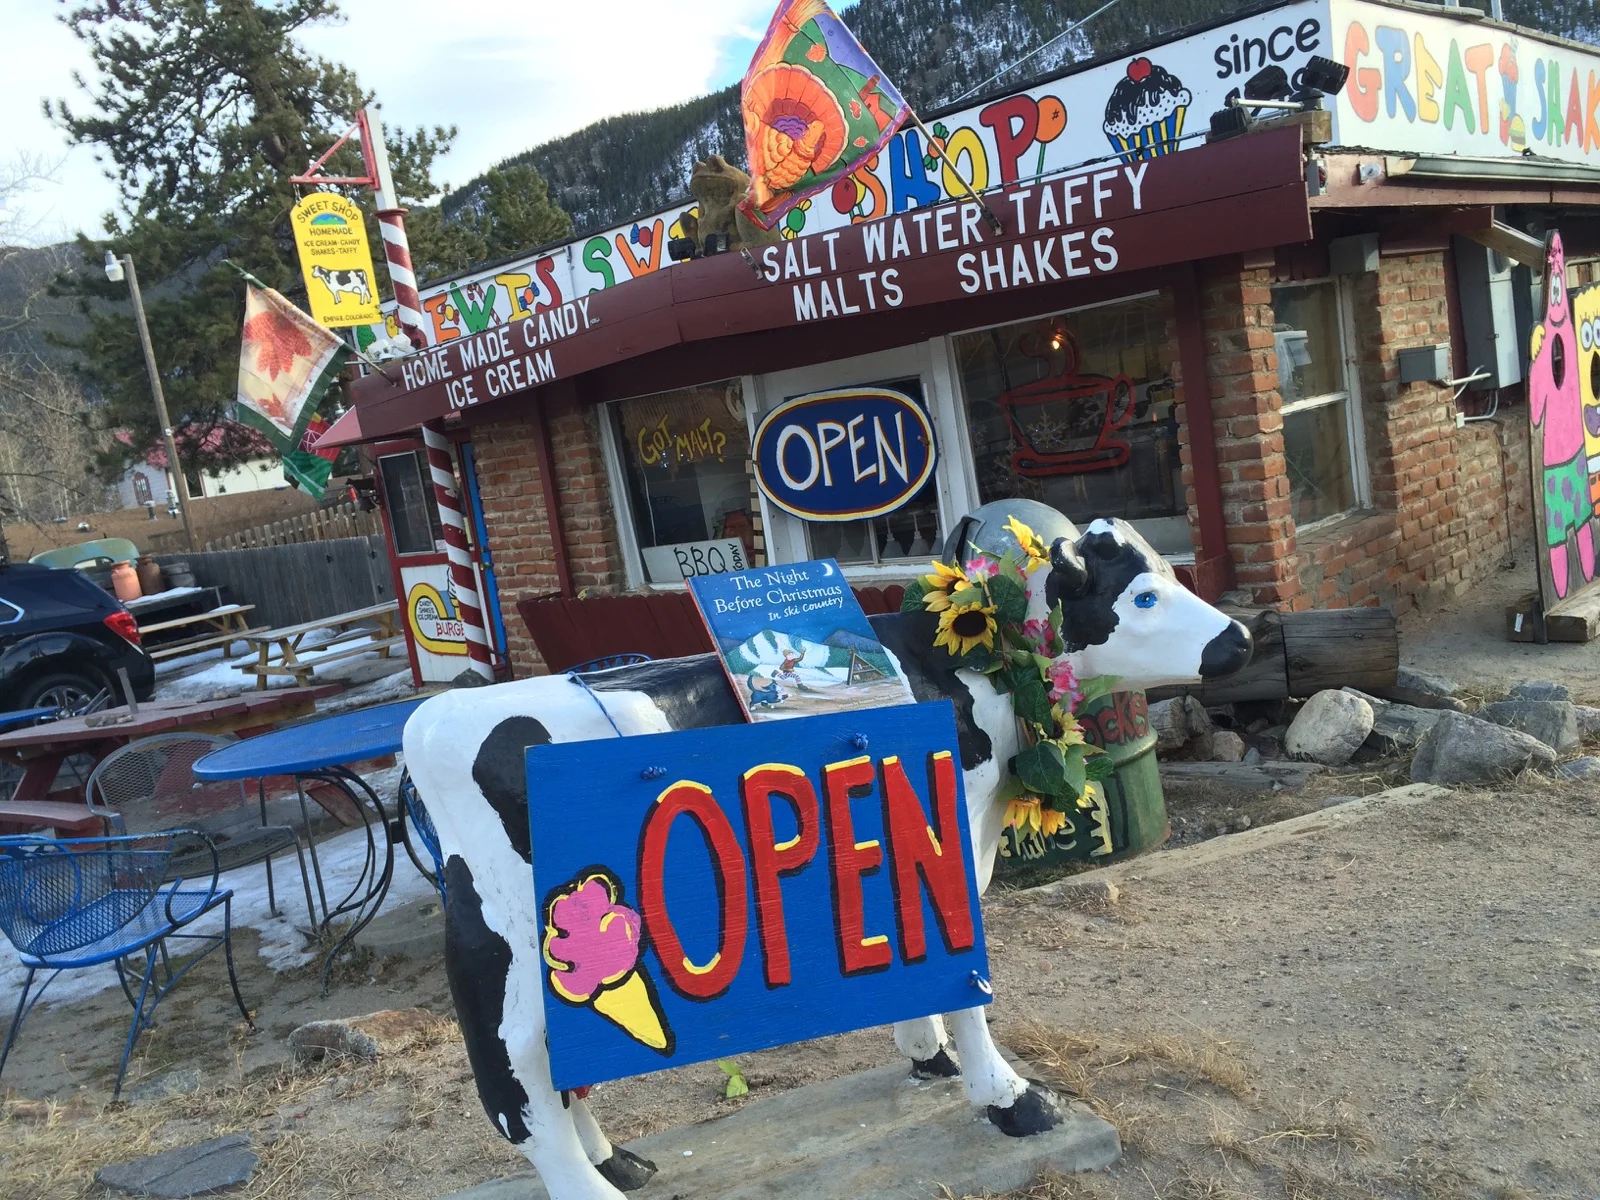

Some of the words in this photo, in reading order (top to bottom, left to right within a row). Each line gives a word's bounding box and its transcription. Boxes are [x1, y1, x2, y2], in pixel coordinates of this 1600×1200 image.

[1214, 17, 1320, 79] since
[1343, 20, 1494, 135] GREAT
[852, 93, 1039, 225] SHOP
[297, 201, 329, 223] SWEET
[331, 201, 359, 221] SHOP
[309, 227, 353, 236] HOMEMADE
[763, 232, 840, 283] SALT
[863, 203, 983, 264] WATER
[1009, 162, 1148, 235] TAFFY
[793, 268, 904, 322] MALTS
[957, 227, 1119, 294] SHAKES
[401, 345, 453, 392] HOME
[461, 324, 516, 372] MADE
[523, 296, 593, 349] CANDY
[445, 375, 479, 410] ICE
[484, 349, 557, 398] CREAM
[775, 411, 911, 491] OPEN
[674, 546, 728, 577] BBQ
[730, 576, 763, 591] The
[764, 569, 810, 586] Night
[714, 595, 764, 615] Before
[766, 584, 843, 605] Christmas
[783, 603, 801, 617] Ski
[802, 596, 844, 612] Country
[639, 752, 974, 1000] OPEN
